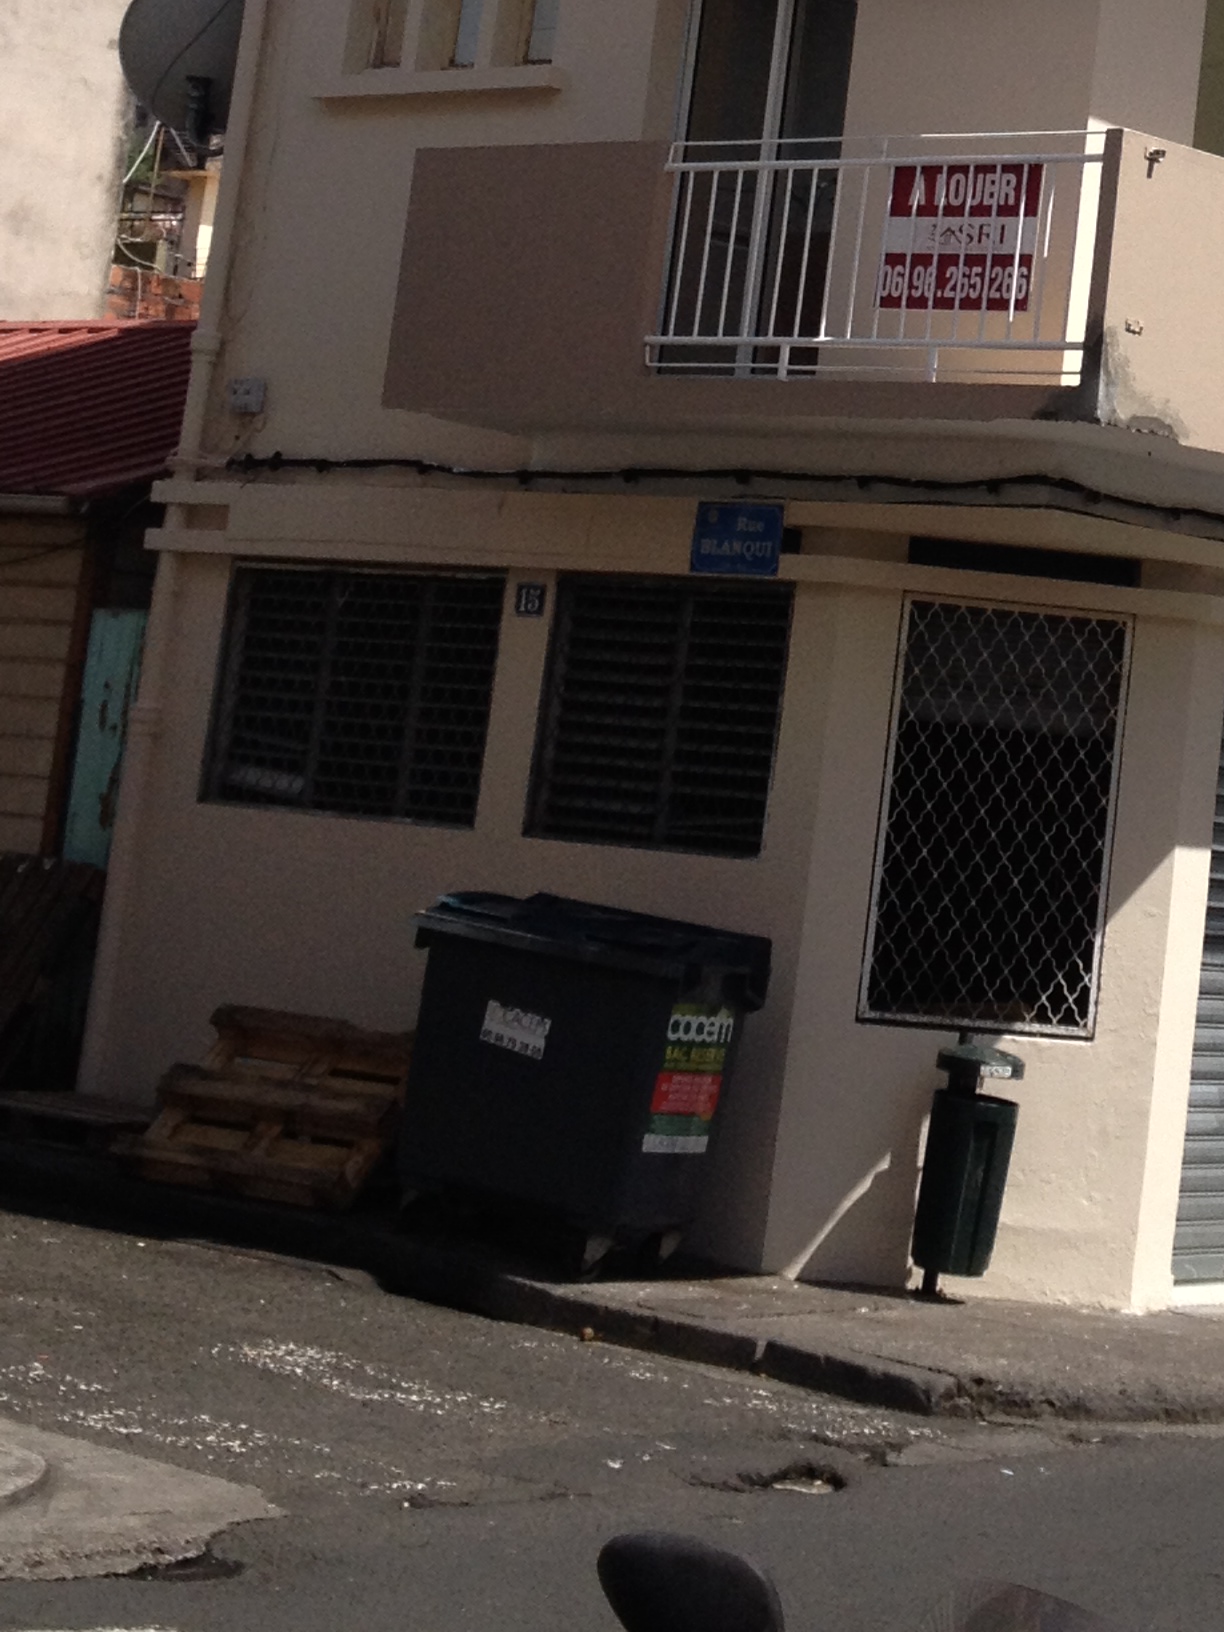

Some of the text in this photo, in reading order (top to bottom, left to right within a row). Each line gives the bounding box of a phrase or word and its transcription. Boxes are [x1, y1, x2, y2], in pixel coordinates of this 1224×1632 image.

[908, 172, 1017, 206] A LOUER
[736, 516, 765, 532] Rue
[701, 538, 773, 561] BLANQUI
